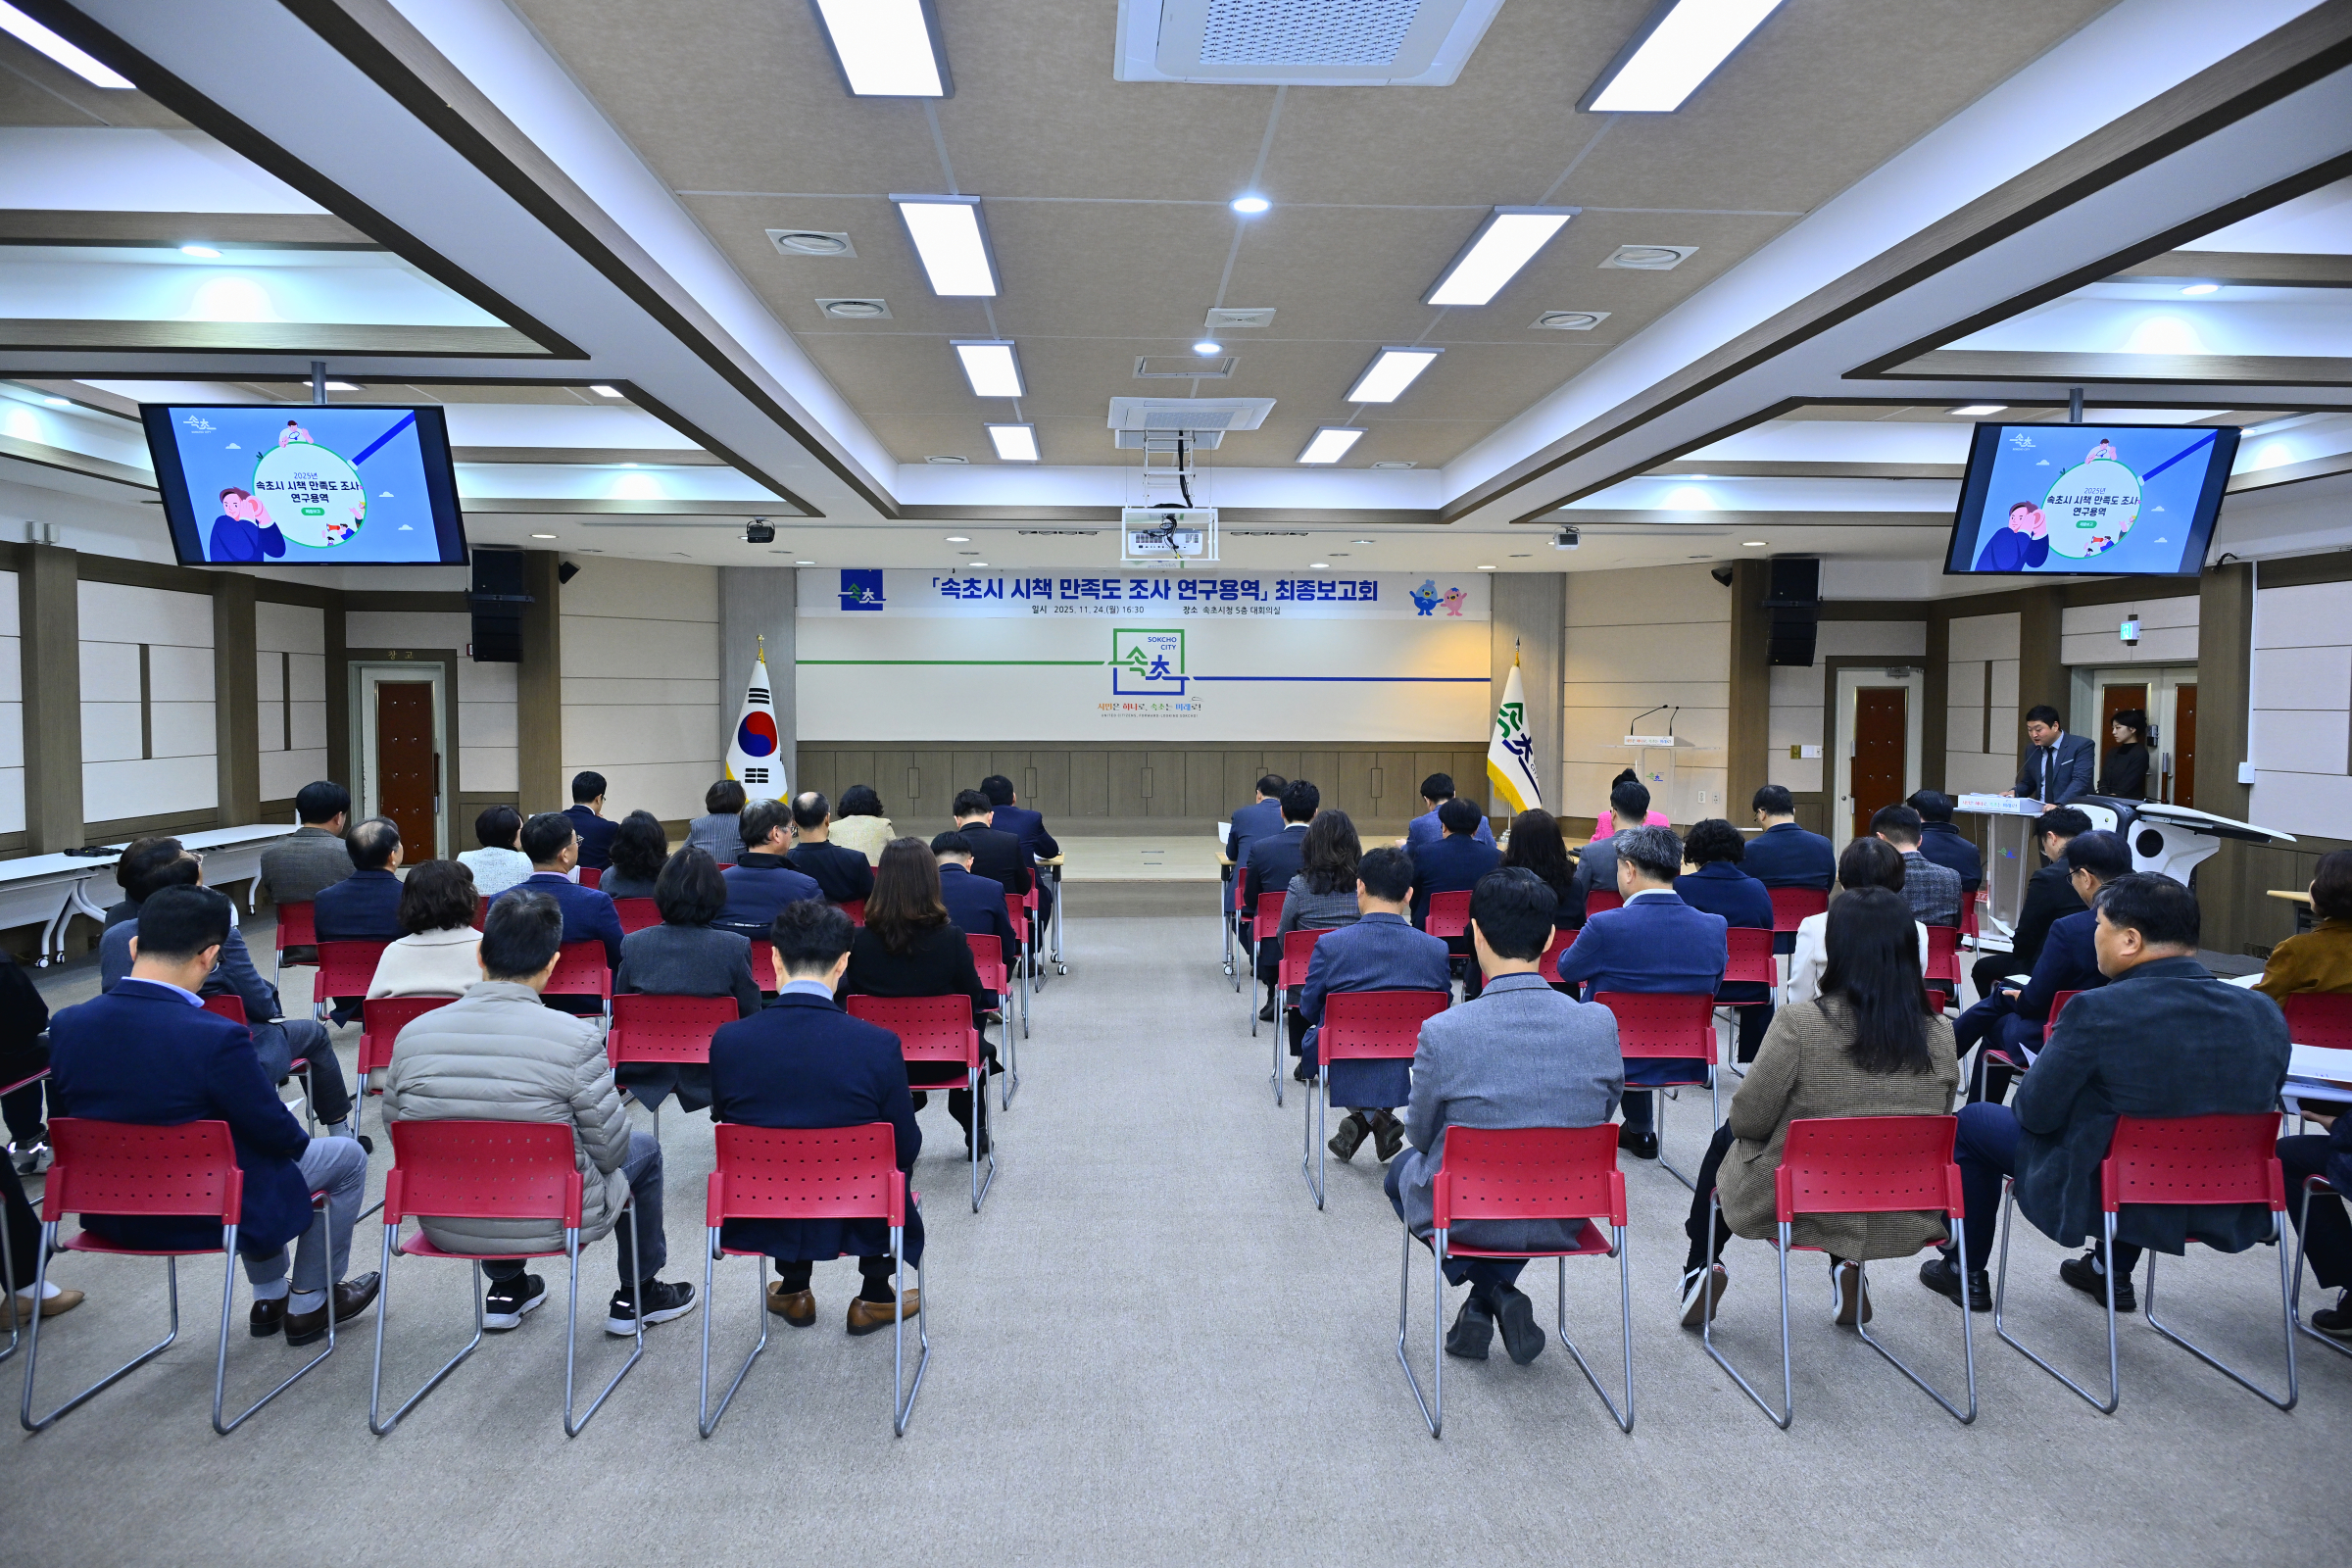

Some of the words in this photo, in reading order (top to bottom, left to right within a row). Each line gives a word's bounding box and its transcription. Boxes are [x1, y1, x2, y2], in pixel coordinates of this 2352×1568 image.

[256, 480, 284, 491] 속초시
[288, 480, 307, 491] 시책
[309, 480, 338, 491] 만족도
[340, 481, 359, 491] 조사
[291, 493, 329, 503] 연구용역
[2047, 495, 2072, 505] 속초시
[2074, 495, 2091, 505] 시책
[2094, 496, 2119, 506] 만족도
[2121, 496, 2138, 506] 조사
[2073, 507, 2106, 516] 연구용역
[1010, 578, 1053, 601] 시책
[1059, 578, 1122, 601] 만족도
[1128, 578, 1171, 601] 조사
[1275, 580, 1378, 602] 최종보고회
[1032, 605, 1048, 614] 일시
[1054, 606, 1077, 614] 2025.
[1079, 606, 1091, 614] 11.
[1122, 606, 1145, 614] 16:30
[1183, 606, 1199, 615] 장소
[1202, 606, 1234, 615] 속초시청
[1235, 606, 1249, 615] 5층
[1250, 606, 1281, 615] 대회의실
